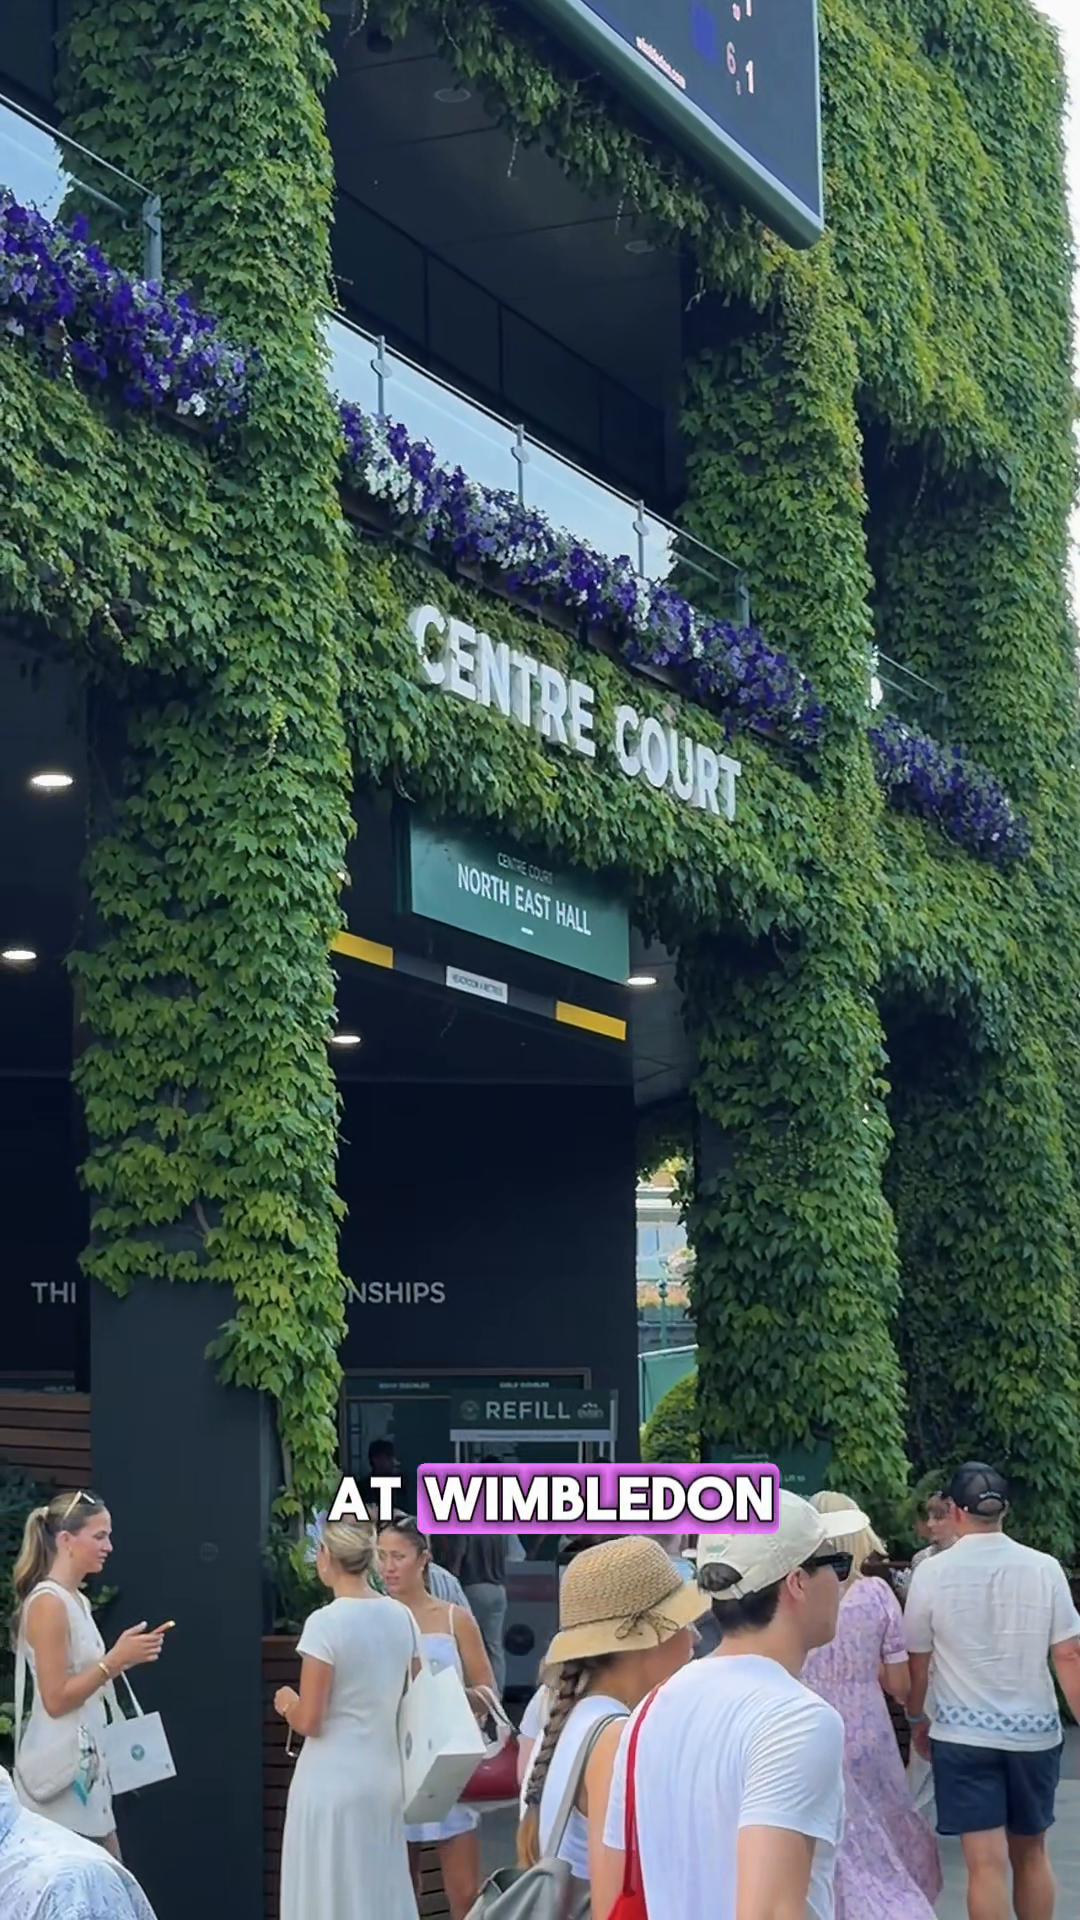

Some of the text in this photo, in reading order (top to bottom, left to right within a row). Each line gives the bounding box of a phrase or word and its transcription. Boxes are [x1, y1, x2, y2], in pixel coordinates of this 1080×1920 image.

[727, 41, 737, 74] 6
[745, 60, 754, 94] 1
[408, 604, 742, 821] CENTRE COURT
[497, 851, 528, 876] CENTRE
[457, 862, 592, 936] NORTH EAST HALL
[343, 1281, 446, 1304] NSHIPS
[486, 1400, 571, 1420] REFILL
